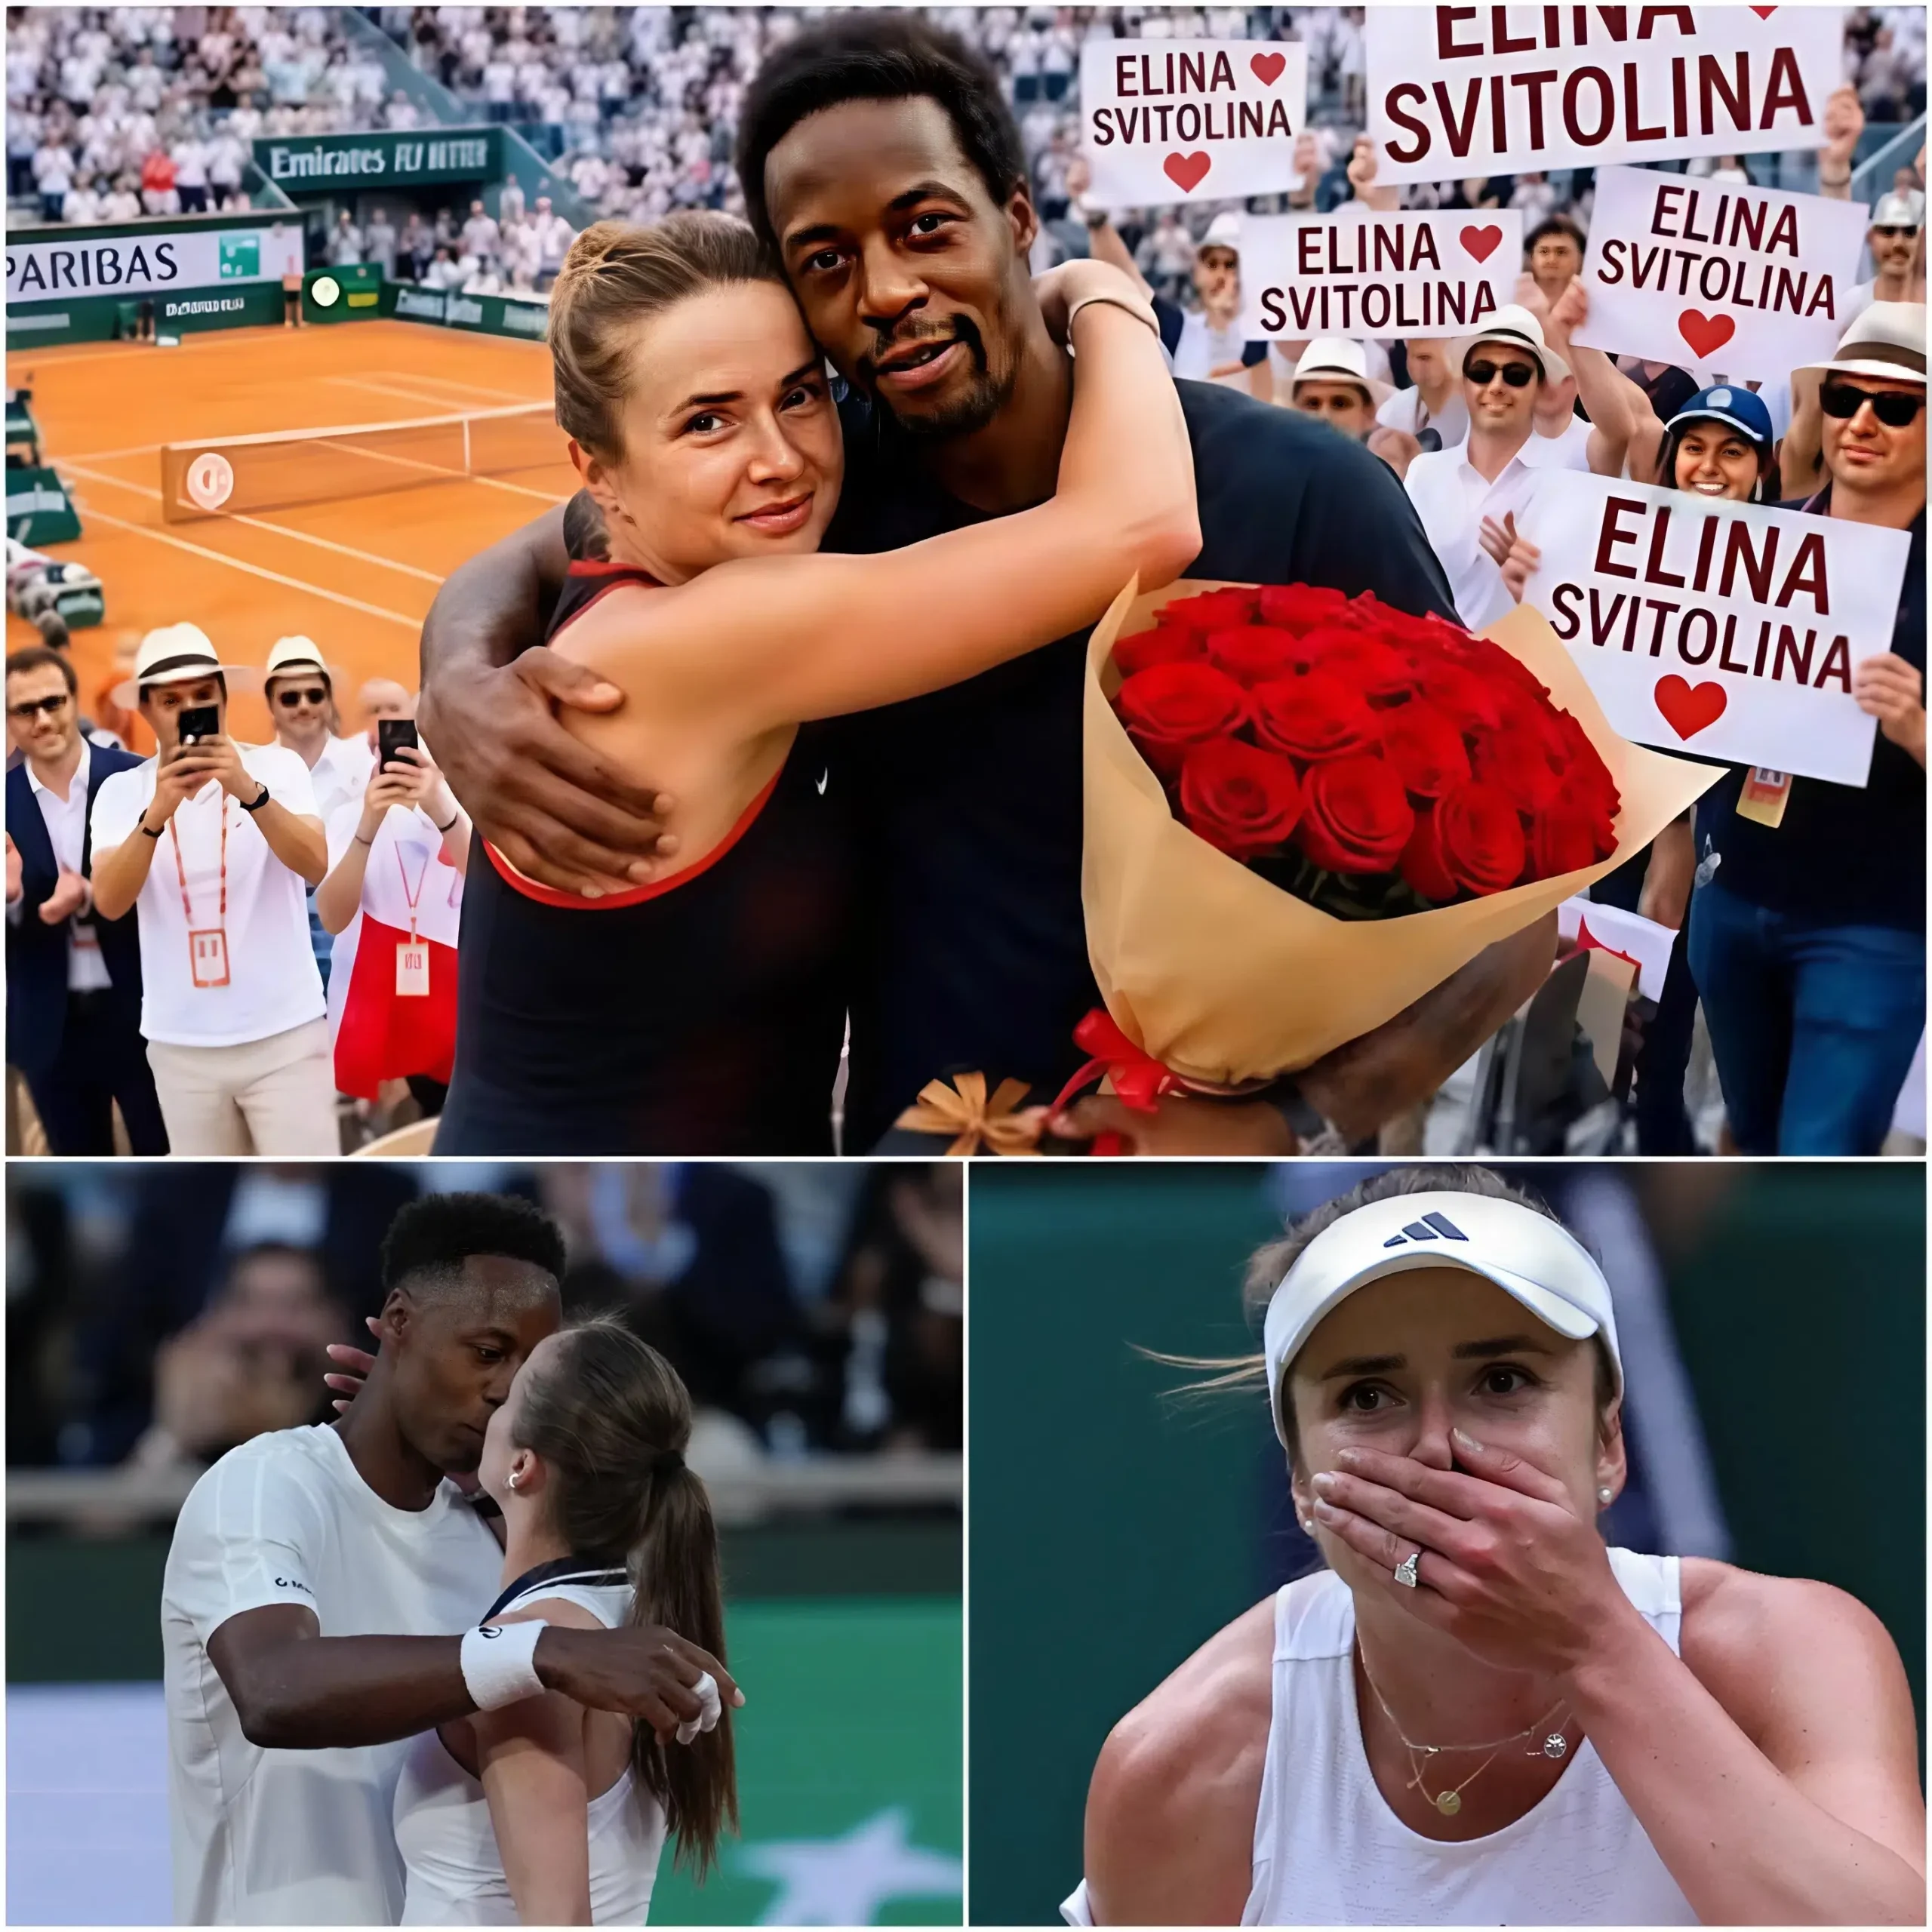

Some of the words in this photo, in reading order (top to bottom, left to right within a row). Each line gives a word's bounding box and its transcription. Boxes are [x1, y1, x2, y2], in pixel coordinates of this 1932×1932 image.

[1116, 51, 1236, 97] ELINA
[1384, 47, 1814, 164] SVITOLINA
[1093, 99, 1292, 146] SVITOLINA
[1298, 223, 1441, 275] ELINA
[1651, 184, 1799, 258] ELINA
[1260, 280, 1497, 332] SVITOLINA
[1597, 239, 1835, 321] SVITOLINA
[1594, 495, 1829, 616] ELINA
[1549, 583, 1852, 694] SVITOLINA
